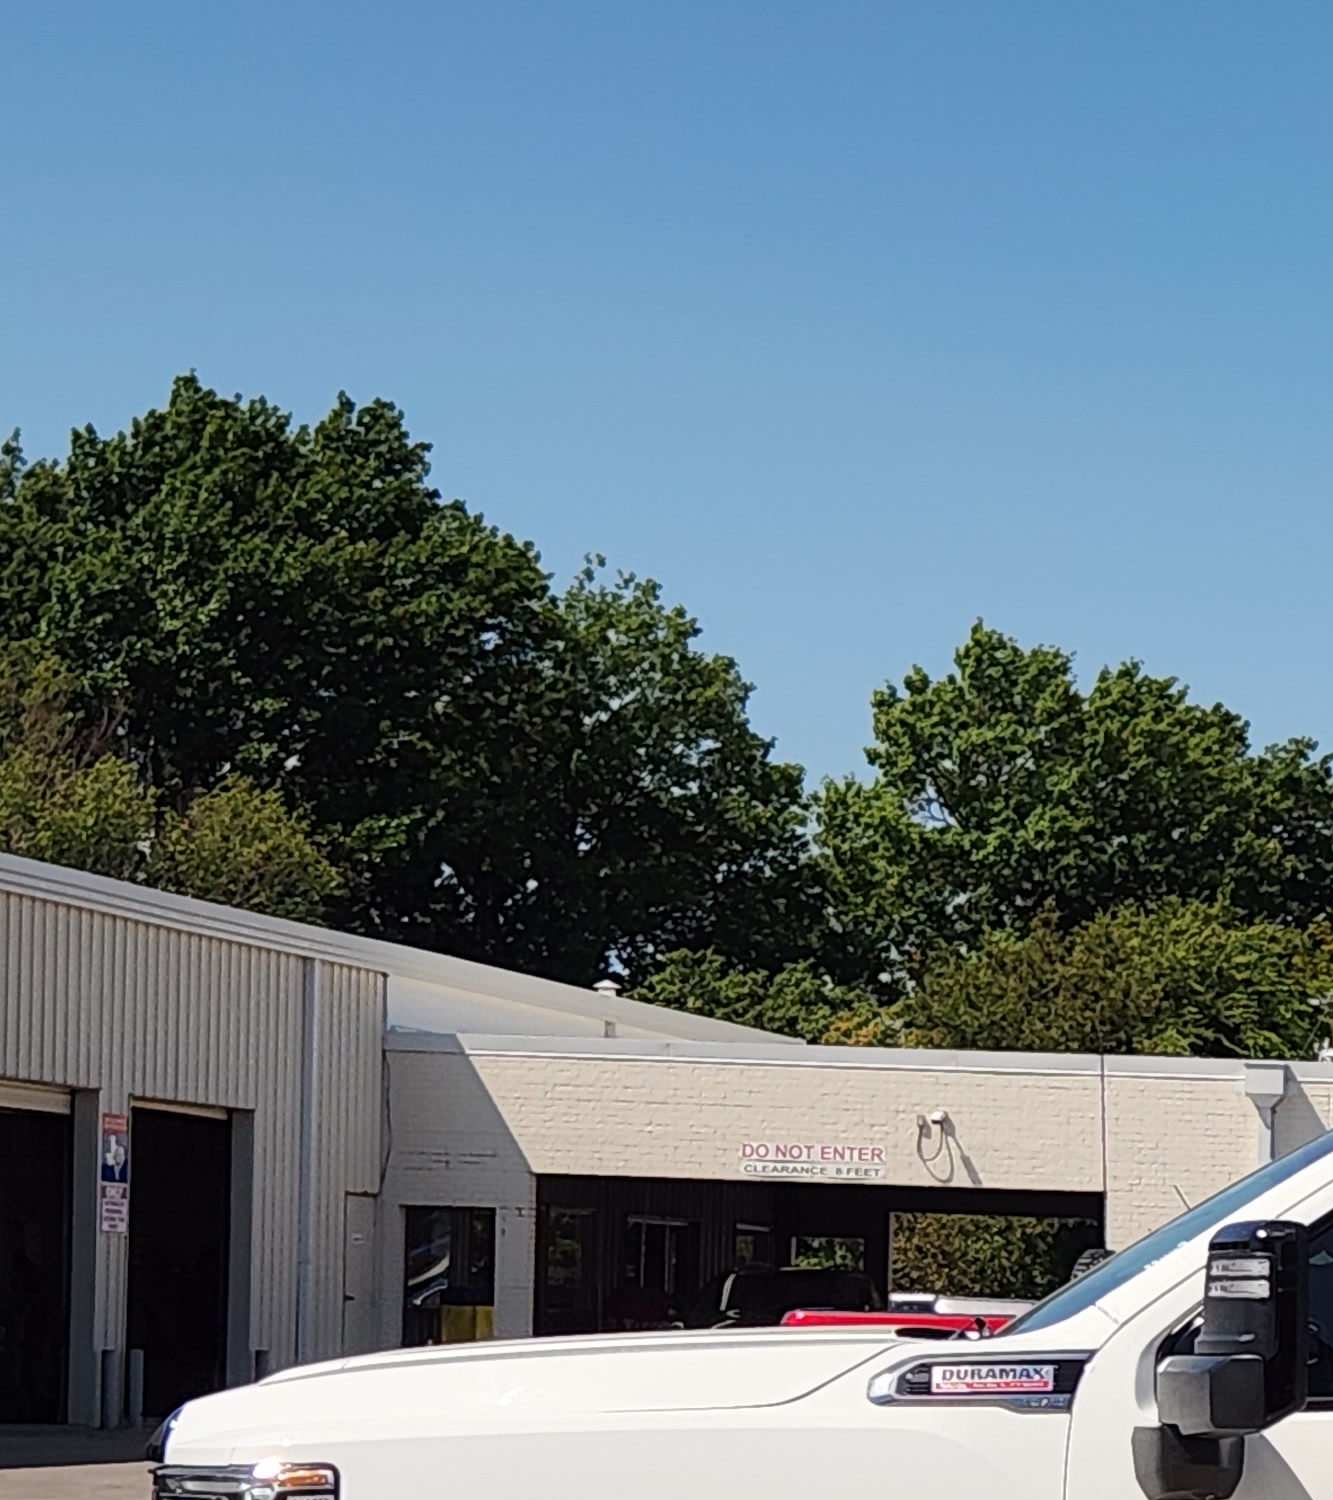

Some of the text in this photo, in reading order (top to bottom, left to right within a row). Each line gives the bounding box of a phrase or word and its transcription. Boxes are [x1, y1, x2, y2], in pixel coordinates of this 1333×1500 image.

[741, 1143, 884, 1162] DO NOT ENTER
[743, 1164, 828, 1175] CLEARANCE
[846, 1167, 881, 1177] FEET
[941, 1367, 1046, 1381] DURAMAX
